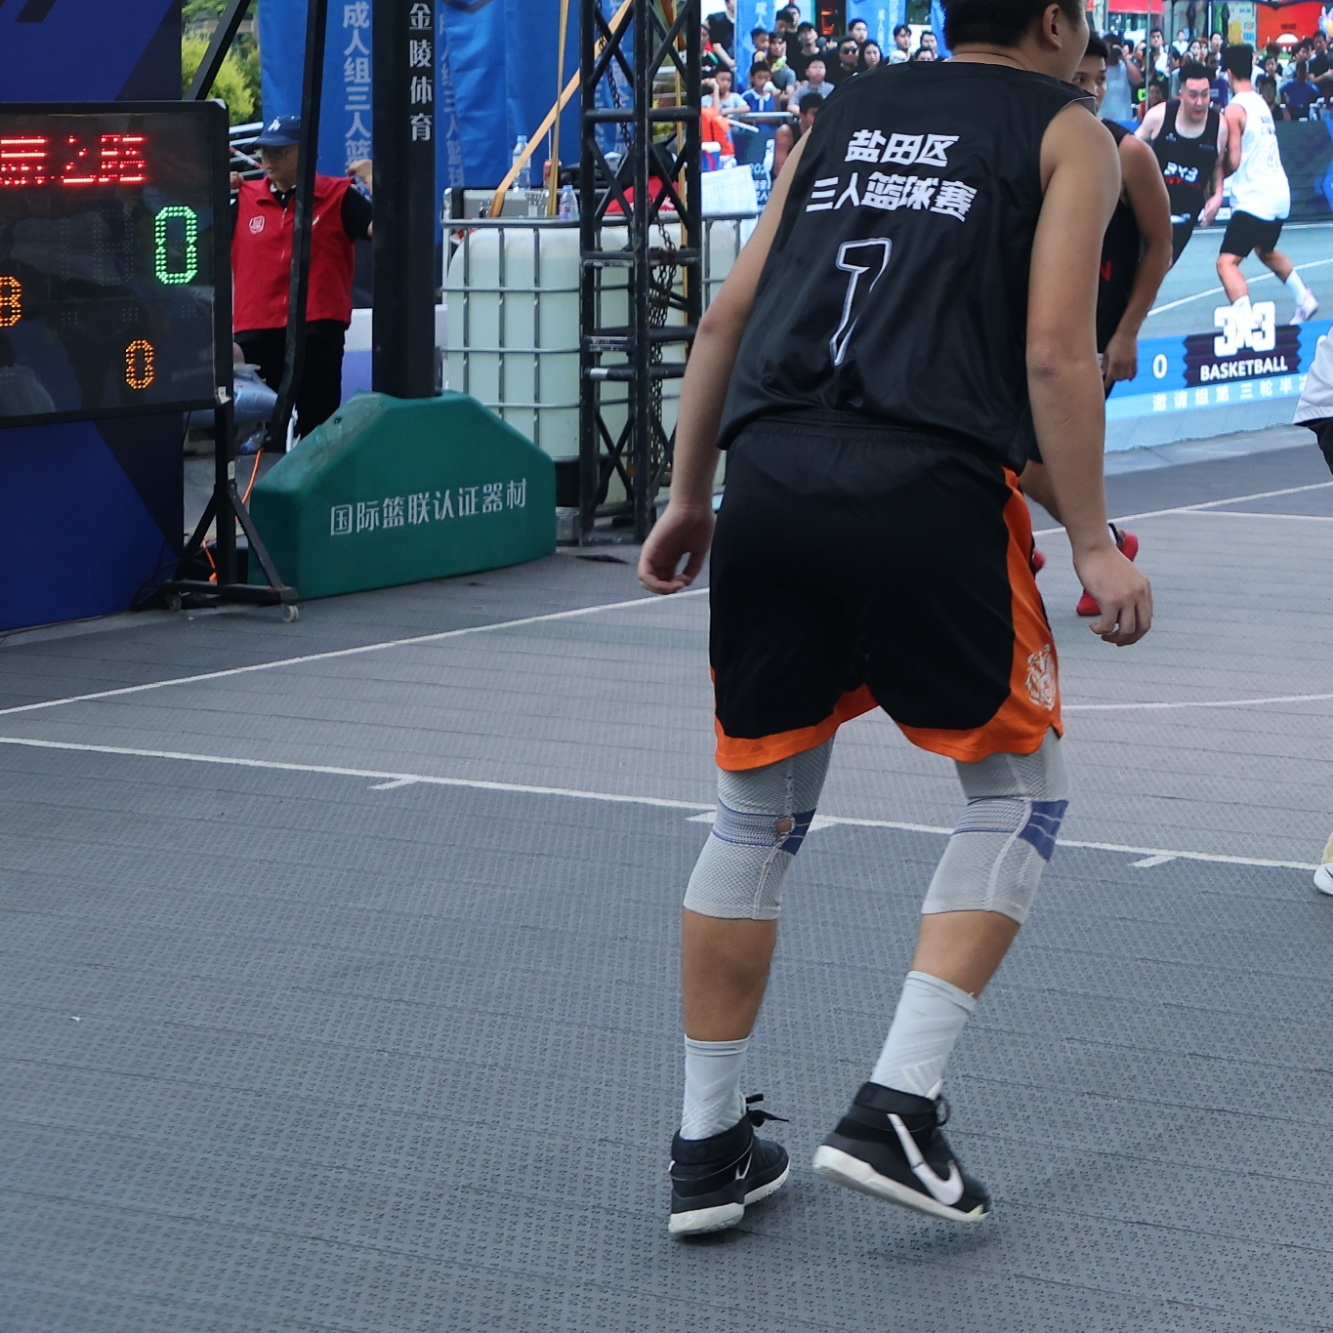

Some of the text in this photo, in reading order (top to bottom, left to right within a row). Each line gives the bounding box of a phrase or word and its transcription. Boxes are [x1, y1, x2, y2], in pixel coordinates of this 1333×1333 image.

[409, 2, 433, 142] 金陵体育
[844, 128, 960, 167] 盐田区
[806, 171, 978, 222] 三人篮球赛
[155, 206, 197, 284] 0
[125, 339, 154, 390] 0
[1200, 355, 1288, 382] BASKETBALL
[331, 478, 528, 536] 国际篮联认证器材
